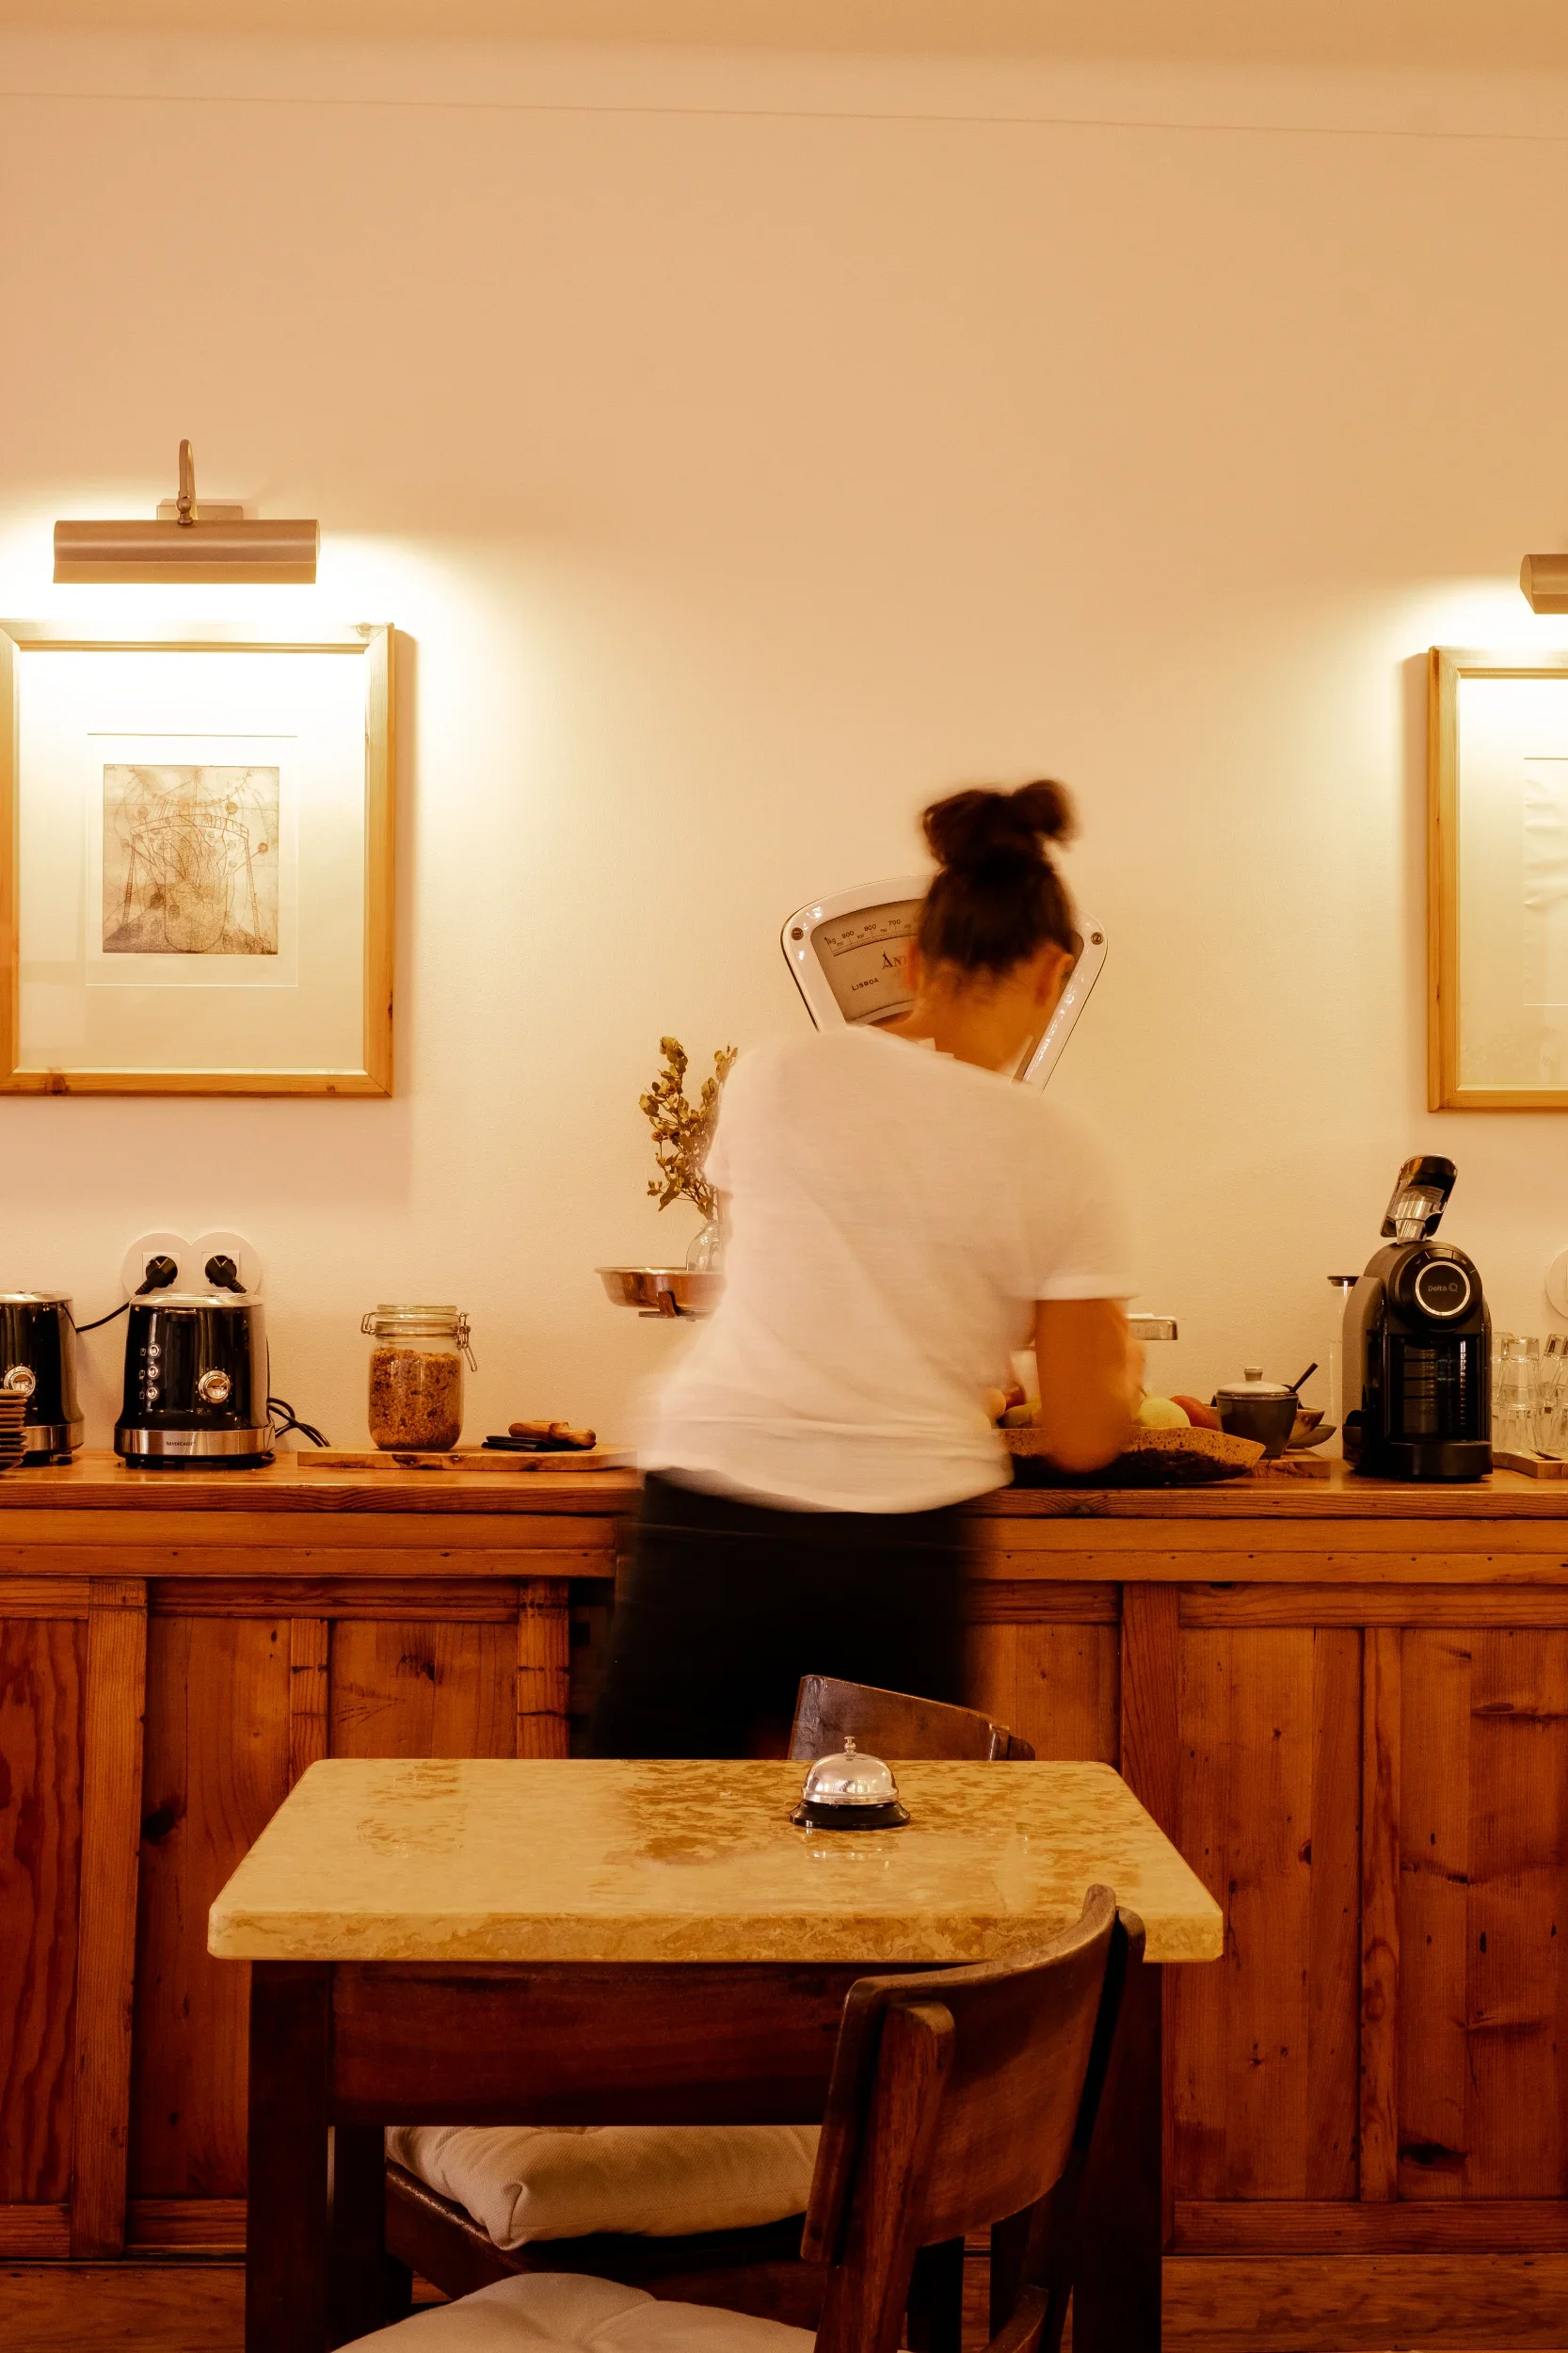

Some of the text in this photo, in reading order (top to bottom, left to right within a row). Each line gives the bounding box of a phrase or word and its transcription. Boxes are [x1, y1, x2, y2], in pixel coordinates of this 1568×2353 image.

[841, 930, 855, 939] 900
[863, 923, 877, 932] 800
[888, 919, 901, 927] 700
[851, 978, 879, 991] LISBOA
